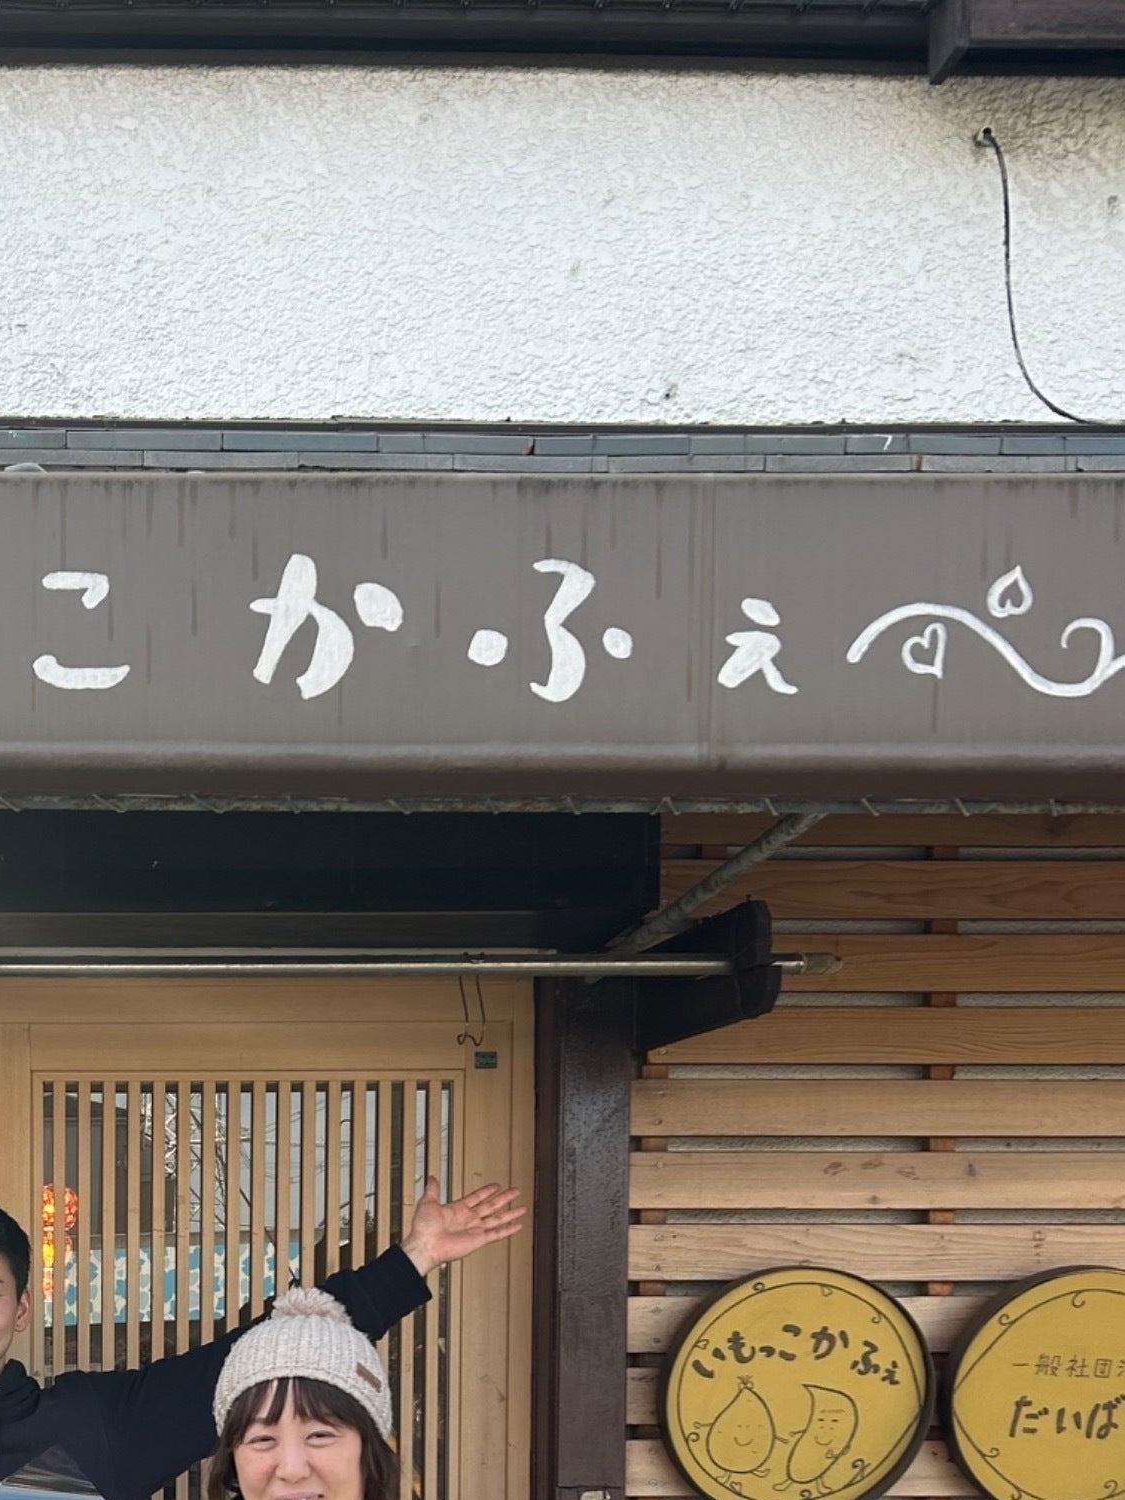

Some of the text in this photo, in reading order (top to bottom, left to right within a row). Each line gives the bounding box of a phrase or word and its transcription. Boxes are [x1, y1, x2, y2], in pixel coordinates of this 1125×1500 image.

[692, 1323, 901, 1386] いもっこかふぇ
